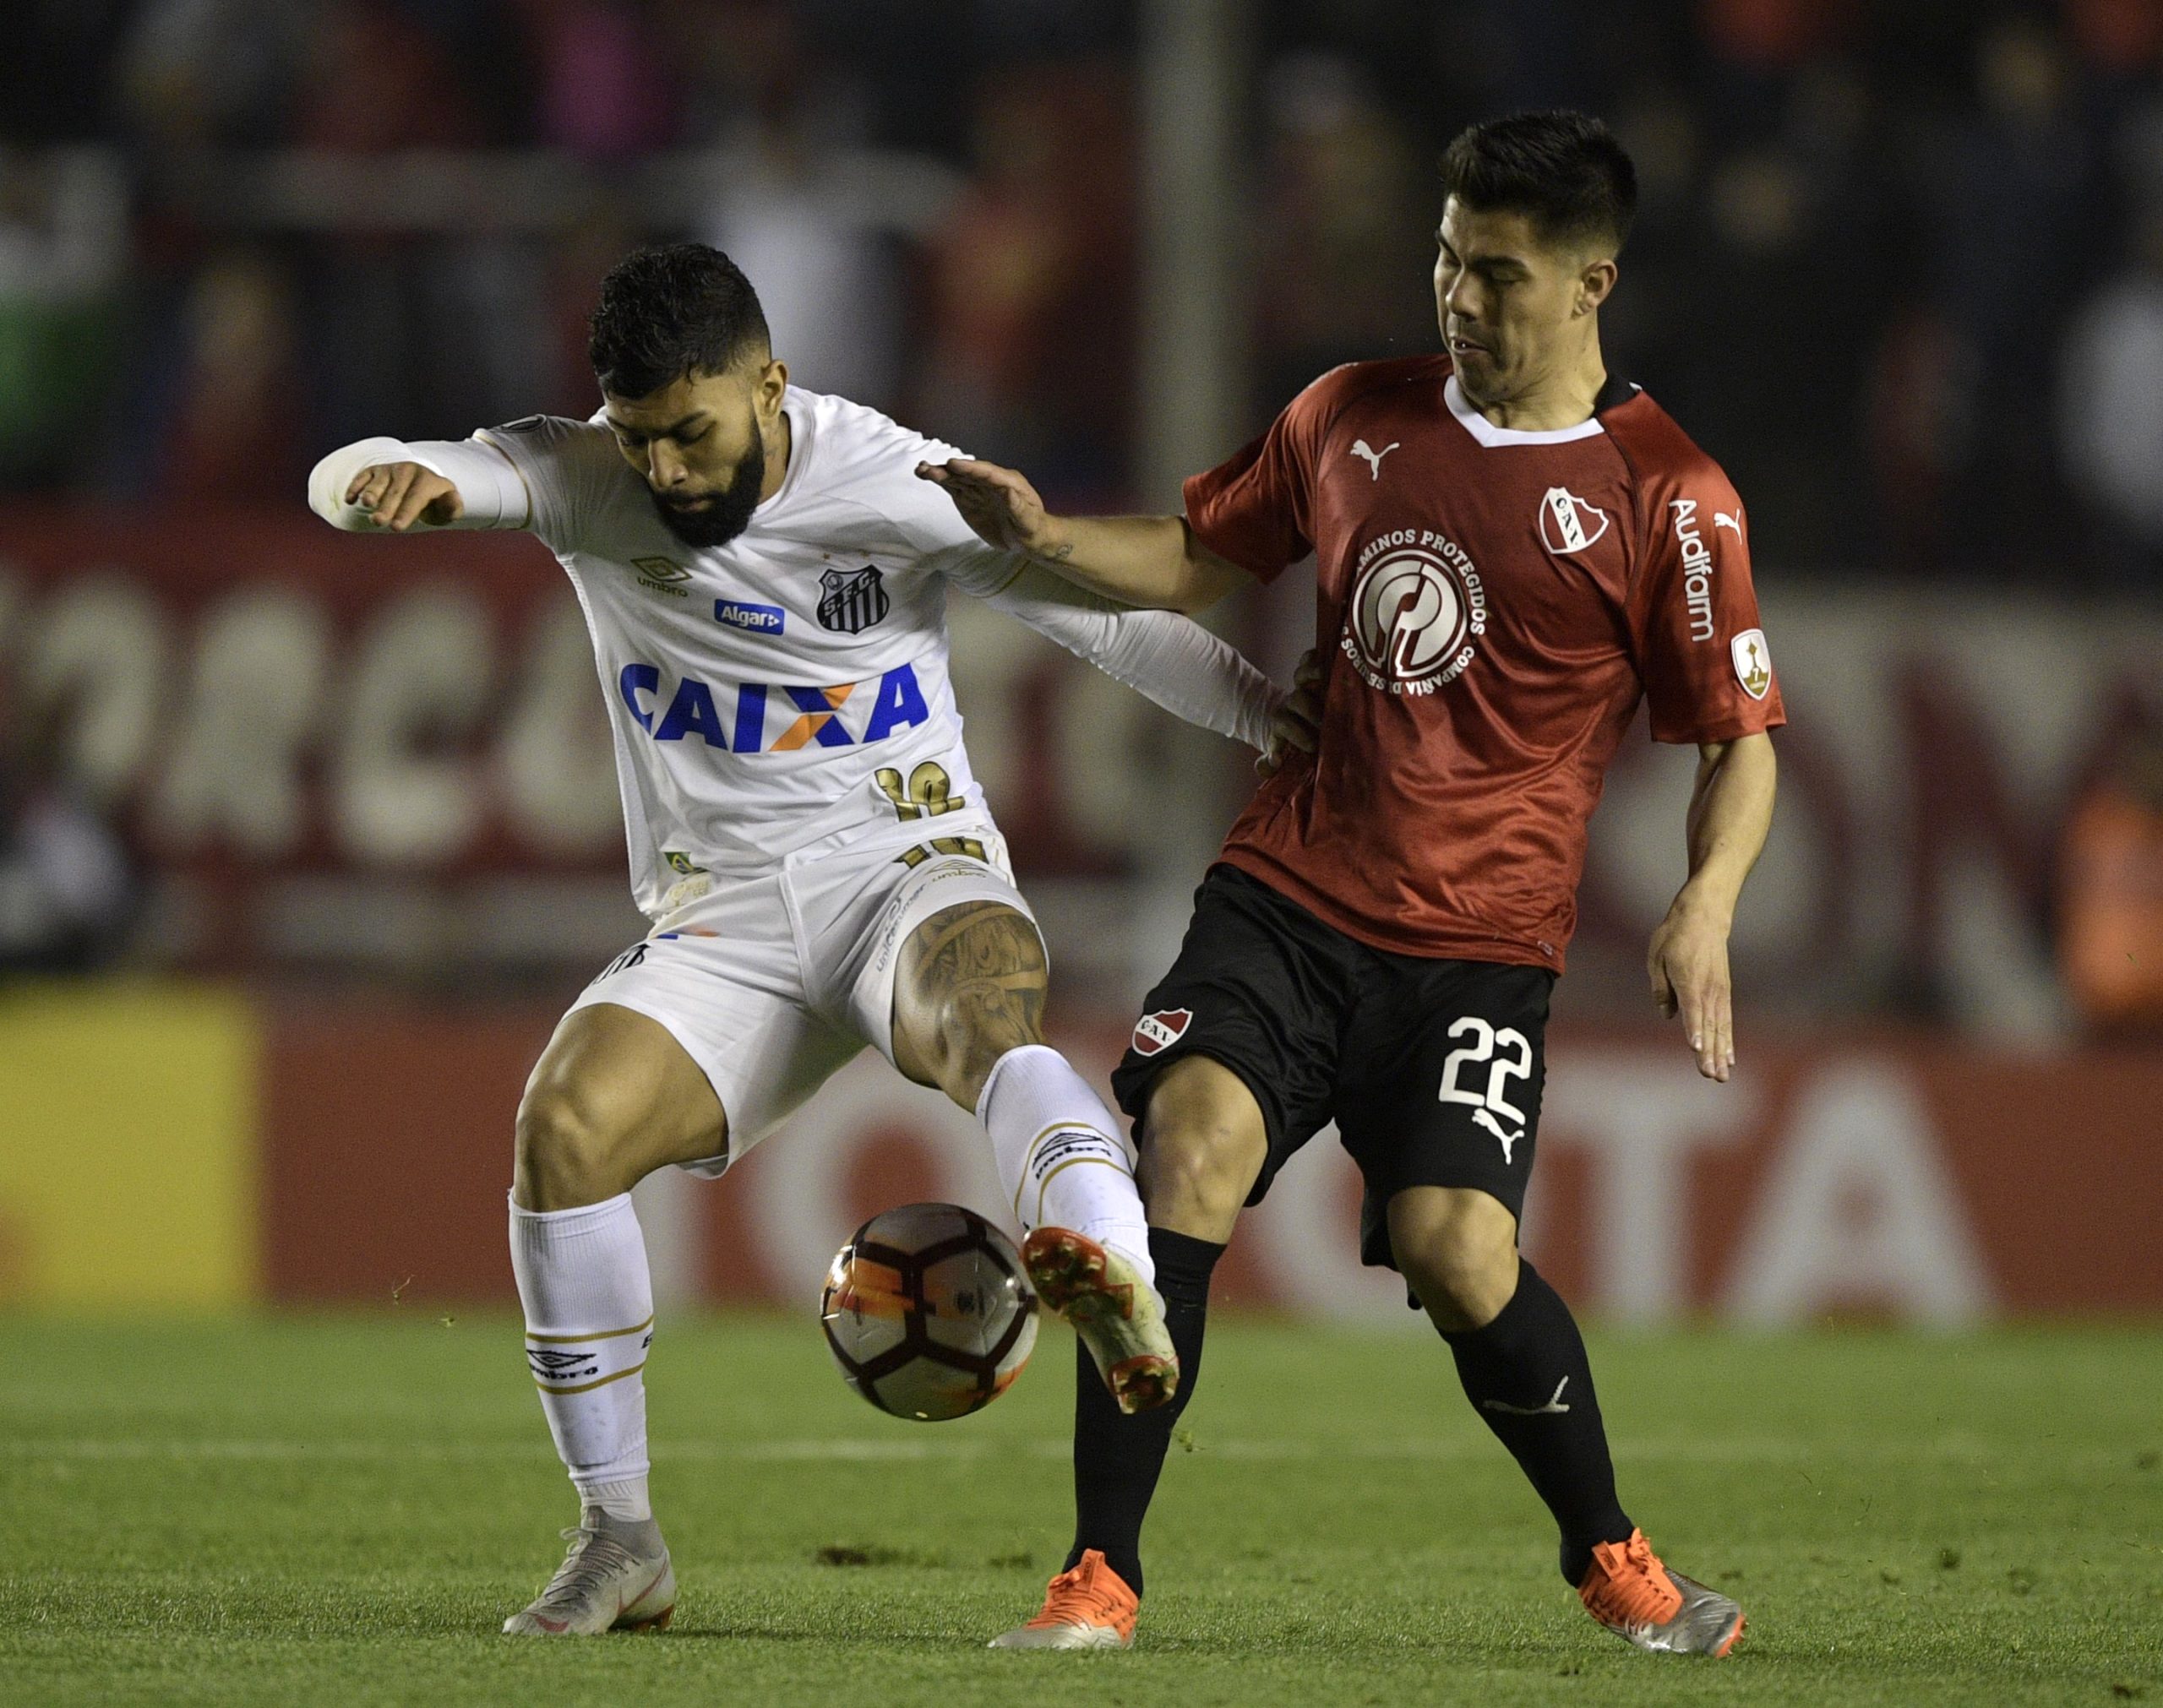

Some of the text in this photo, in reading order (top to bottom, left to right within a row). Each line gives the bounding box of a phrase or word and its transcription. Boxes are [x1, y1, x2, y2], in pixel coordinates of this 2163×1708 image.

[637, 576, 689, 597] umbro
[721, 605, 767, 628] Algar
[1419, 530, 1487, 635] PROTEGIDOS
[1669, 499, 1714, 642] Audifarm
[620, 662, 929, 753] CAIXA
[1438, 1016, 1533, 1125] 22
